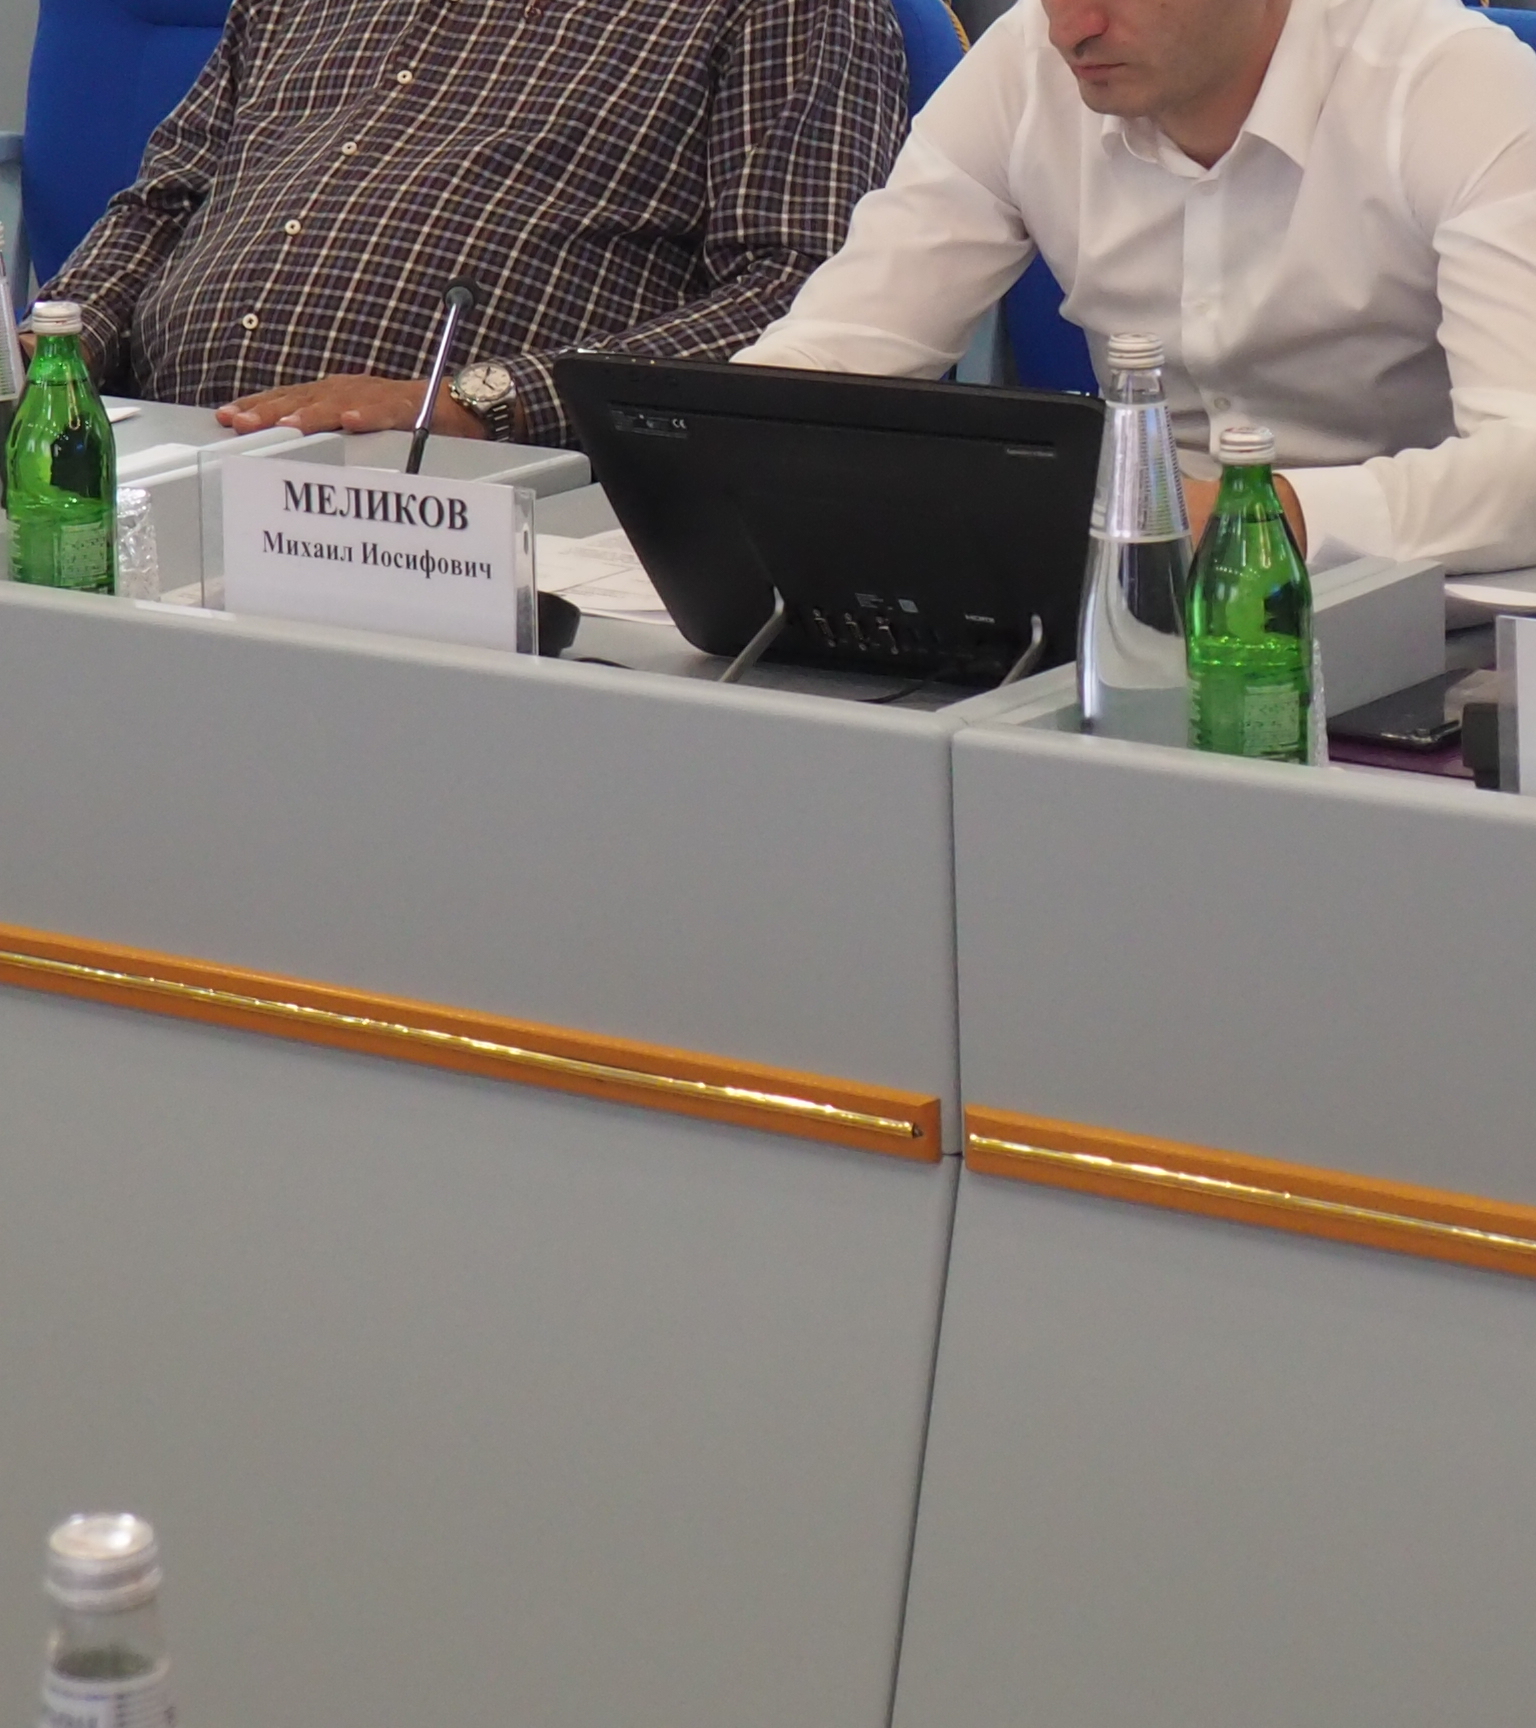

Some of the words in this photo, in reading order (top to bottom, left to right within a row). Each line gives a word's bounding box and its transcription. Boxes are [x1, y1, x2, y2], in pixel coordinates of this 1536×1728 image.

[282, 479, 469, 531] МЕЛИКОВ
[262, 529, 353, 563] Михаил
[361, 541, 493, 580] Иосифович
